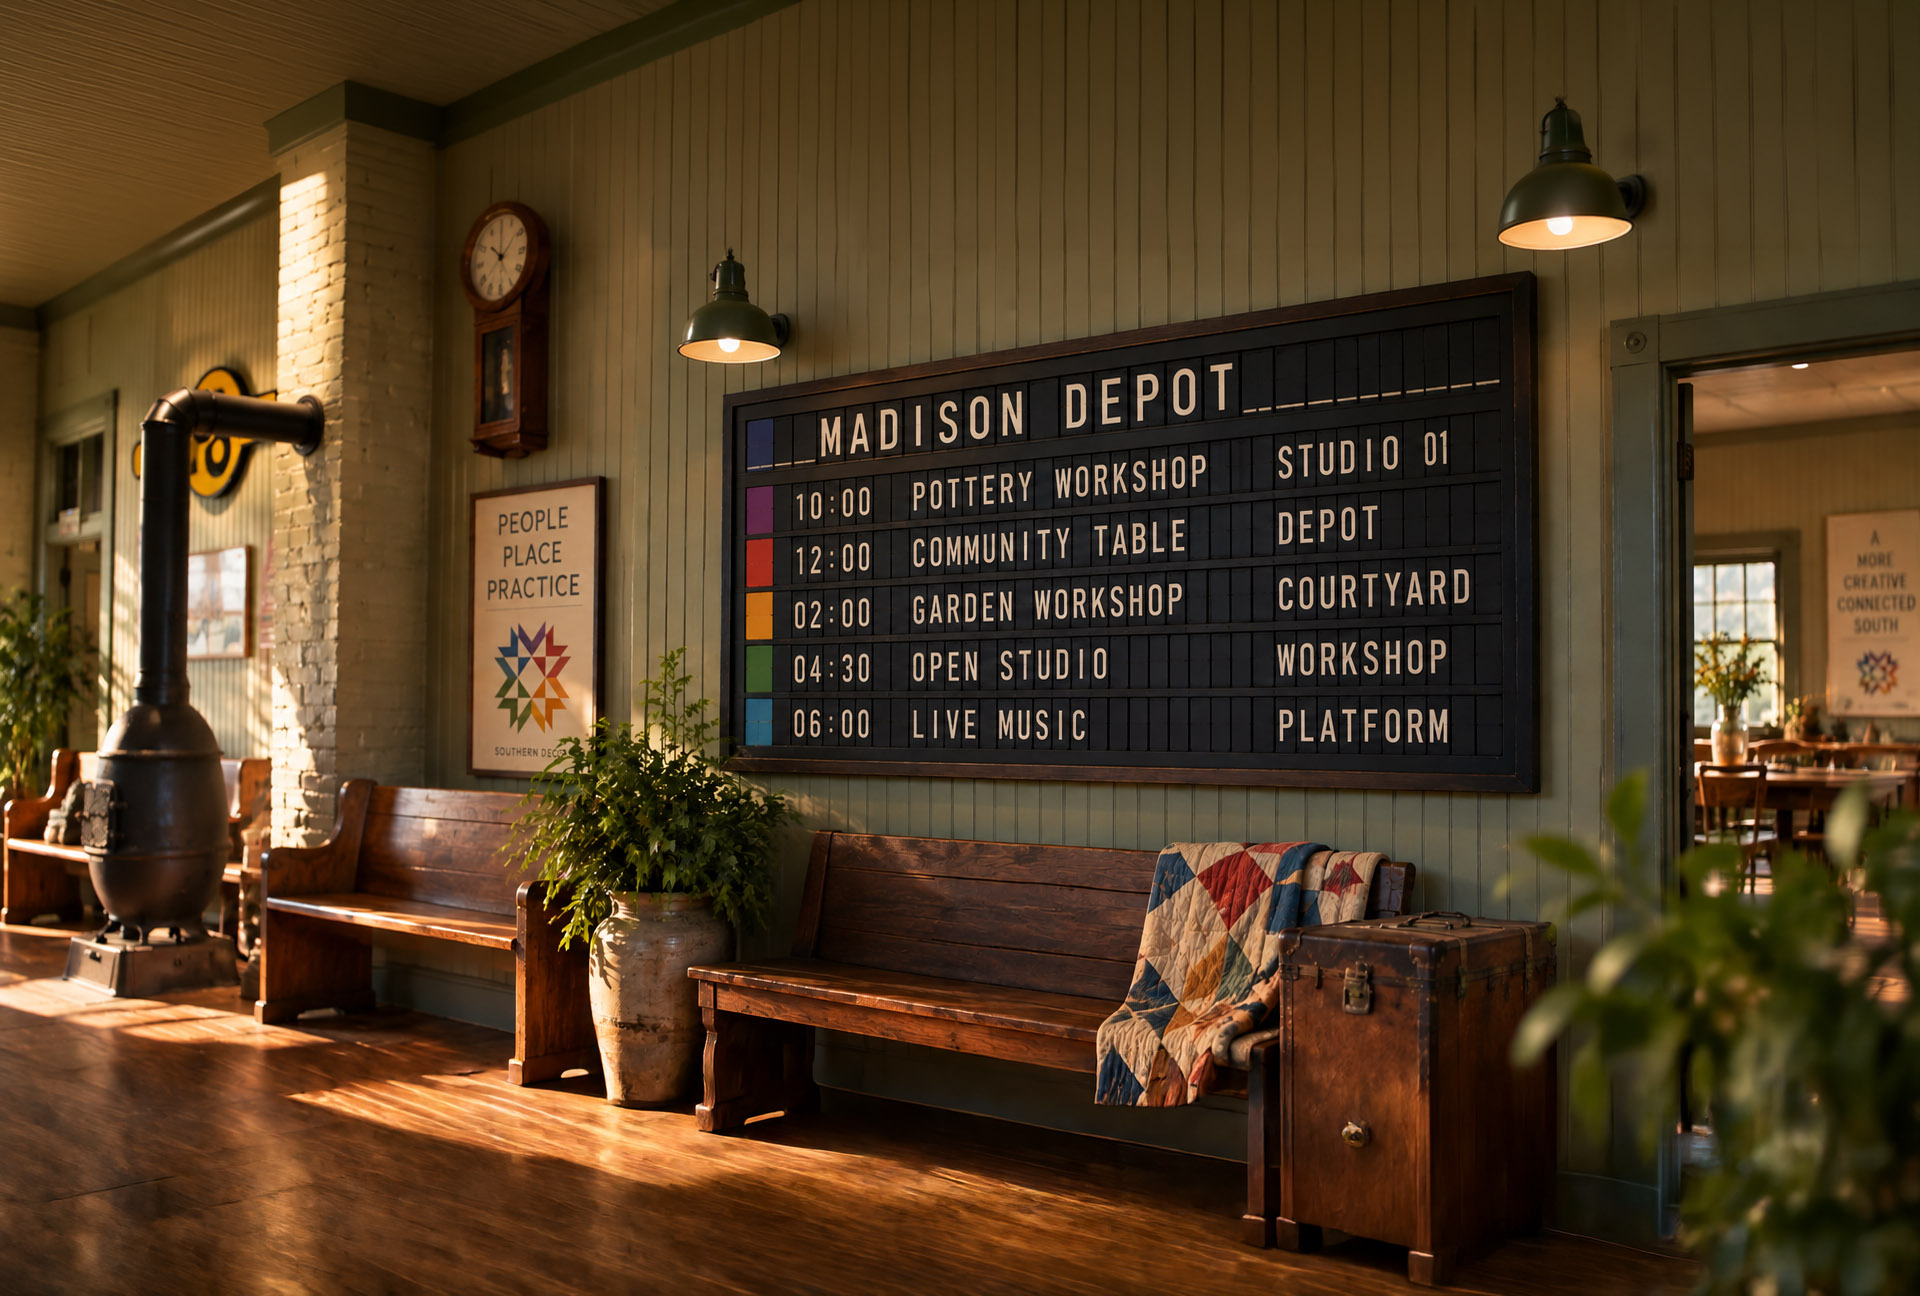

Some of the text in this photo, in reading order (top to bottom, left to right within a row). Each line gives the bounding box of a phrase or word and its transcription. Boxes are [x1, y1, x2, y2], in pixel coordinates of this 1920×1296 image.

[820, 362, 1233, 458] MADISON DEPOT
[796, 430, 1447, 521] 10:00 POTTERY WORKSHOP STUDIO 01
[499, 506, 568, 536] PEOPLE
[796, 505, 1378, 575] 12:00 COMMUNITY TABLE DEPOT
[1870, 530, 1880, 546] A
[504, 541, 562, 567] PLACE
[1857, 553, 1893, 568] MORE
[488, 574, 579, 600] PRACTICE
[1843, 573, 1907, 590] CREATIVE
[794, 568, 1470, 630] 02:00 GARDEN WORKSHOP COURTYARD
[1837, 595, 1916, 612] CONNECTED
[1854, 617, 1899, 634] SOUTH
[794, 639, 1447, 684] 04:30 OPEN STUDIO WORKSHOP
[794, 708, 1448, 744] 06:00 LIVE MUSIC PLATFORM
[495, 747, 538, 757] SOUTHERN
